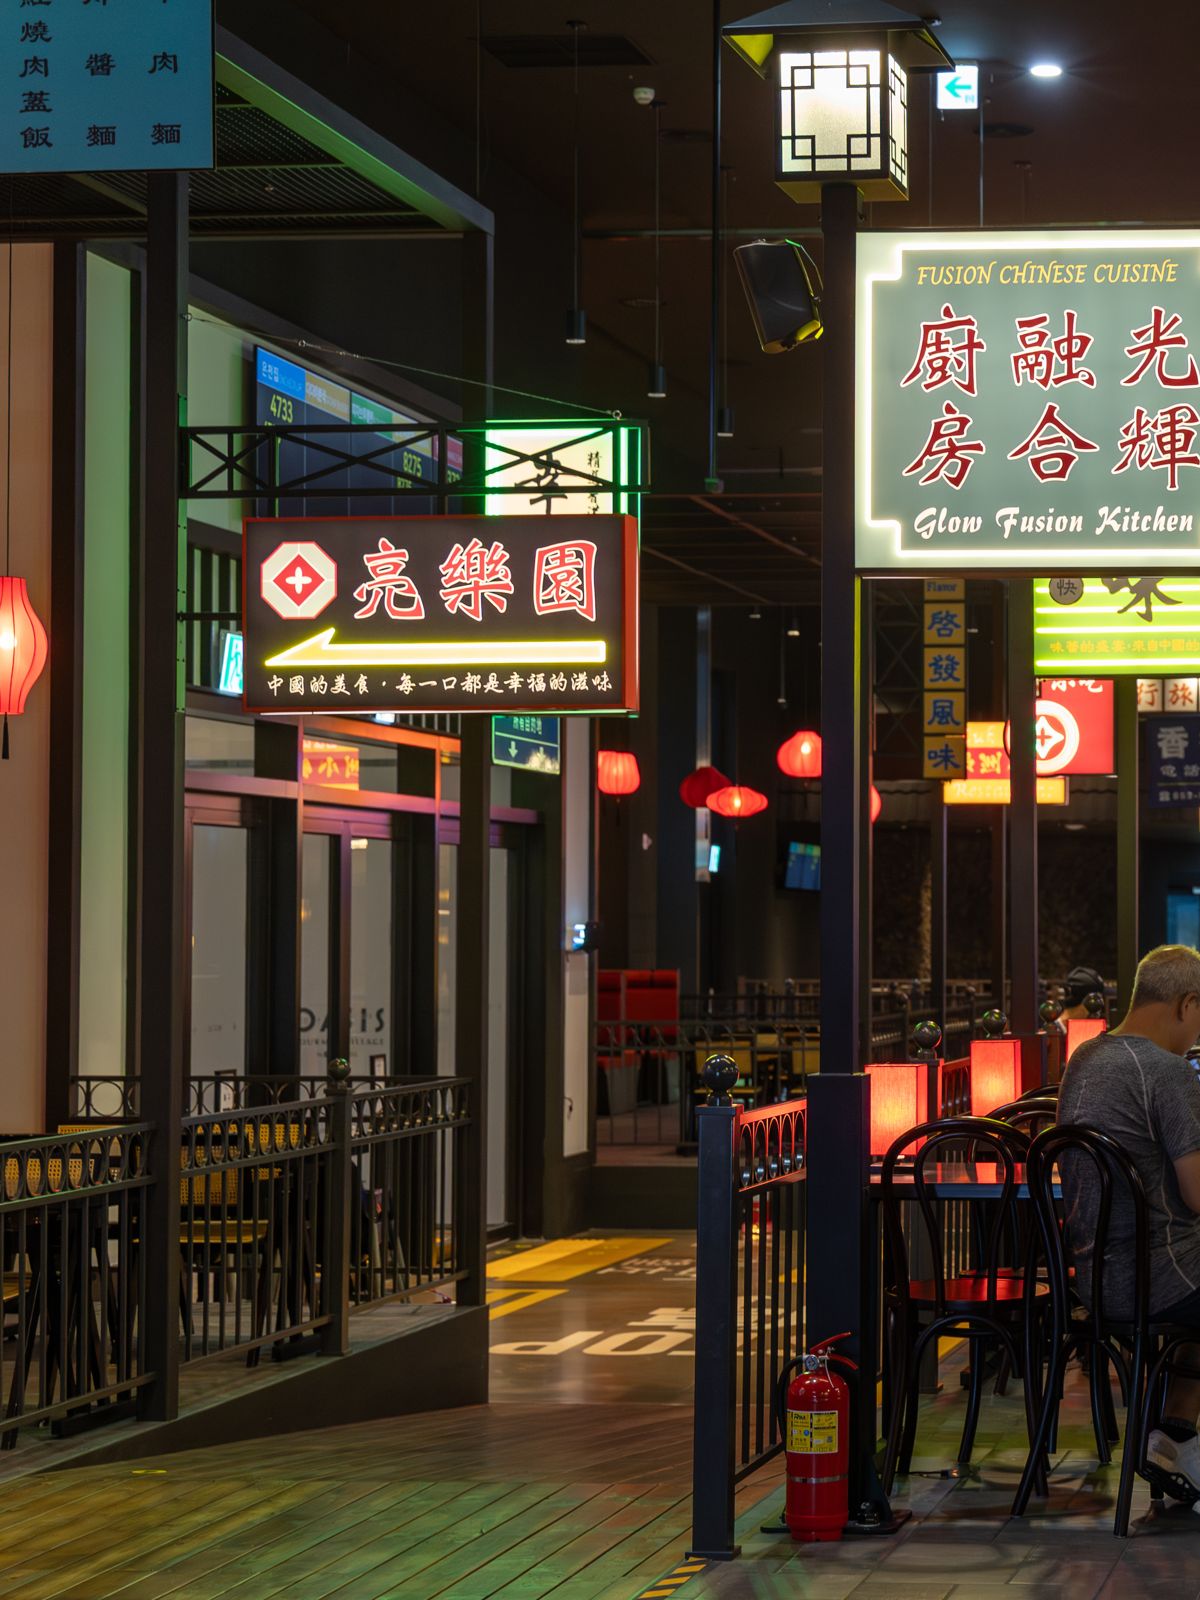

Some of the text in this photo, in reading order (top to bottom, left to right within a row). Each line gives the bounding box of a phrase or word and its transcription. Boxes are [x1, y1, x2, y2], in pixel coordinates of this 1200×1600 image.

[83, 0, 116, 147] 醬麵
[149, 0, 181, 145] 肉麵
[917, 258, 1179, 286] FUSION CHINESE CUISINE
[269, 393, 294, 424] 4733
[402, 451, 422, 478] 8275
[914, 504, 1194, 541] Glow Fusion Kitchen
[353, 537, 598, 621] 亮樂園
